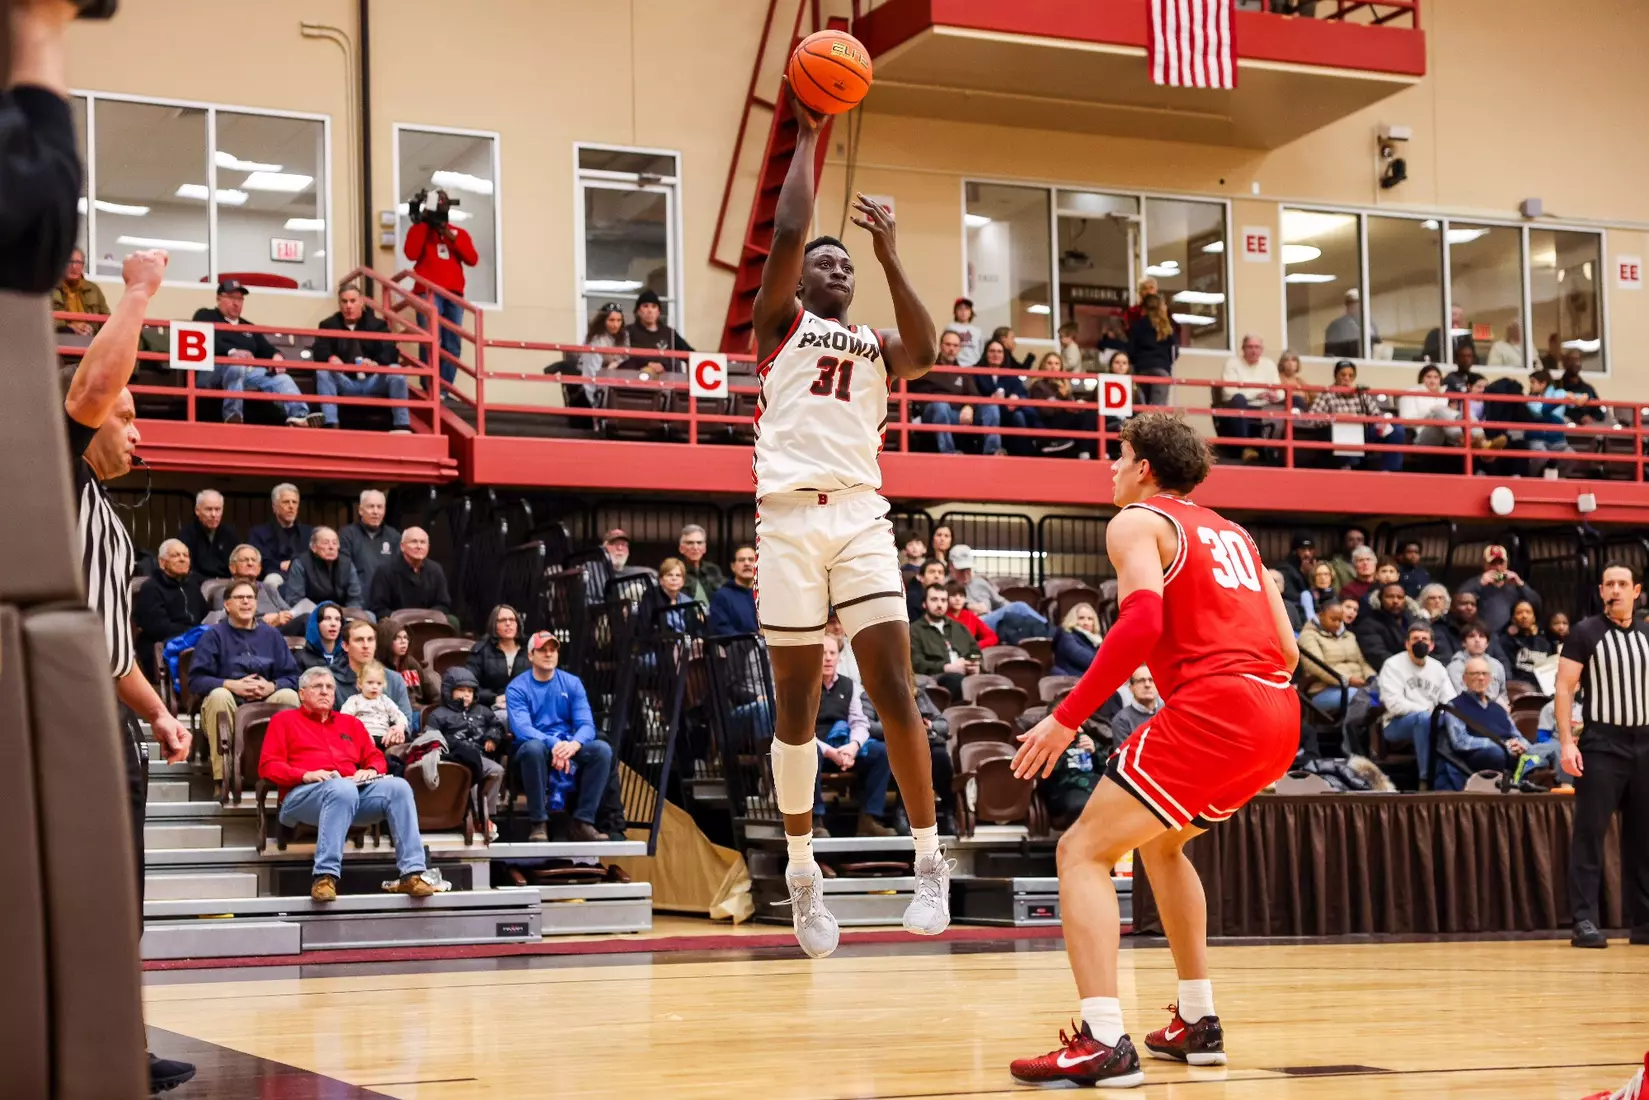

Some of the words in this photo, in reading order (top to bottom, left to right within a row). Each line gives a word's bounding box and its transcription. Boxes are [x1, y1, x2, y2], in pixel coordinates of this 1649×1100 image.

[1247, 235, 1267, 253] EE
[1620, 264, 1639, 280] EE
[178, 329, 207, 362] B
[798, 331, 880, 362] BROWN
[695, 360, 721, 390] C
[809, 355, 854, 402] 31
[1105, 382, 1127, 408] D
[818, 494, 828, 505] B
[1197, 526, 1262, 592] 30
